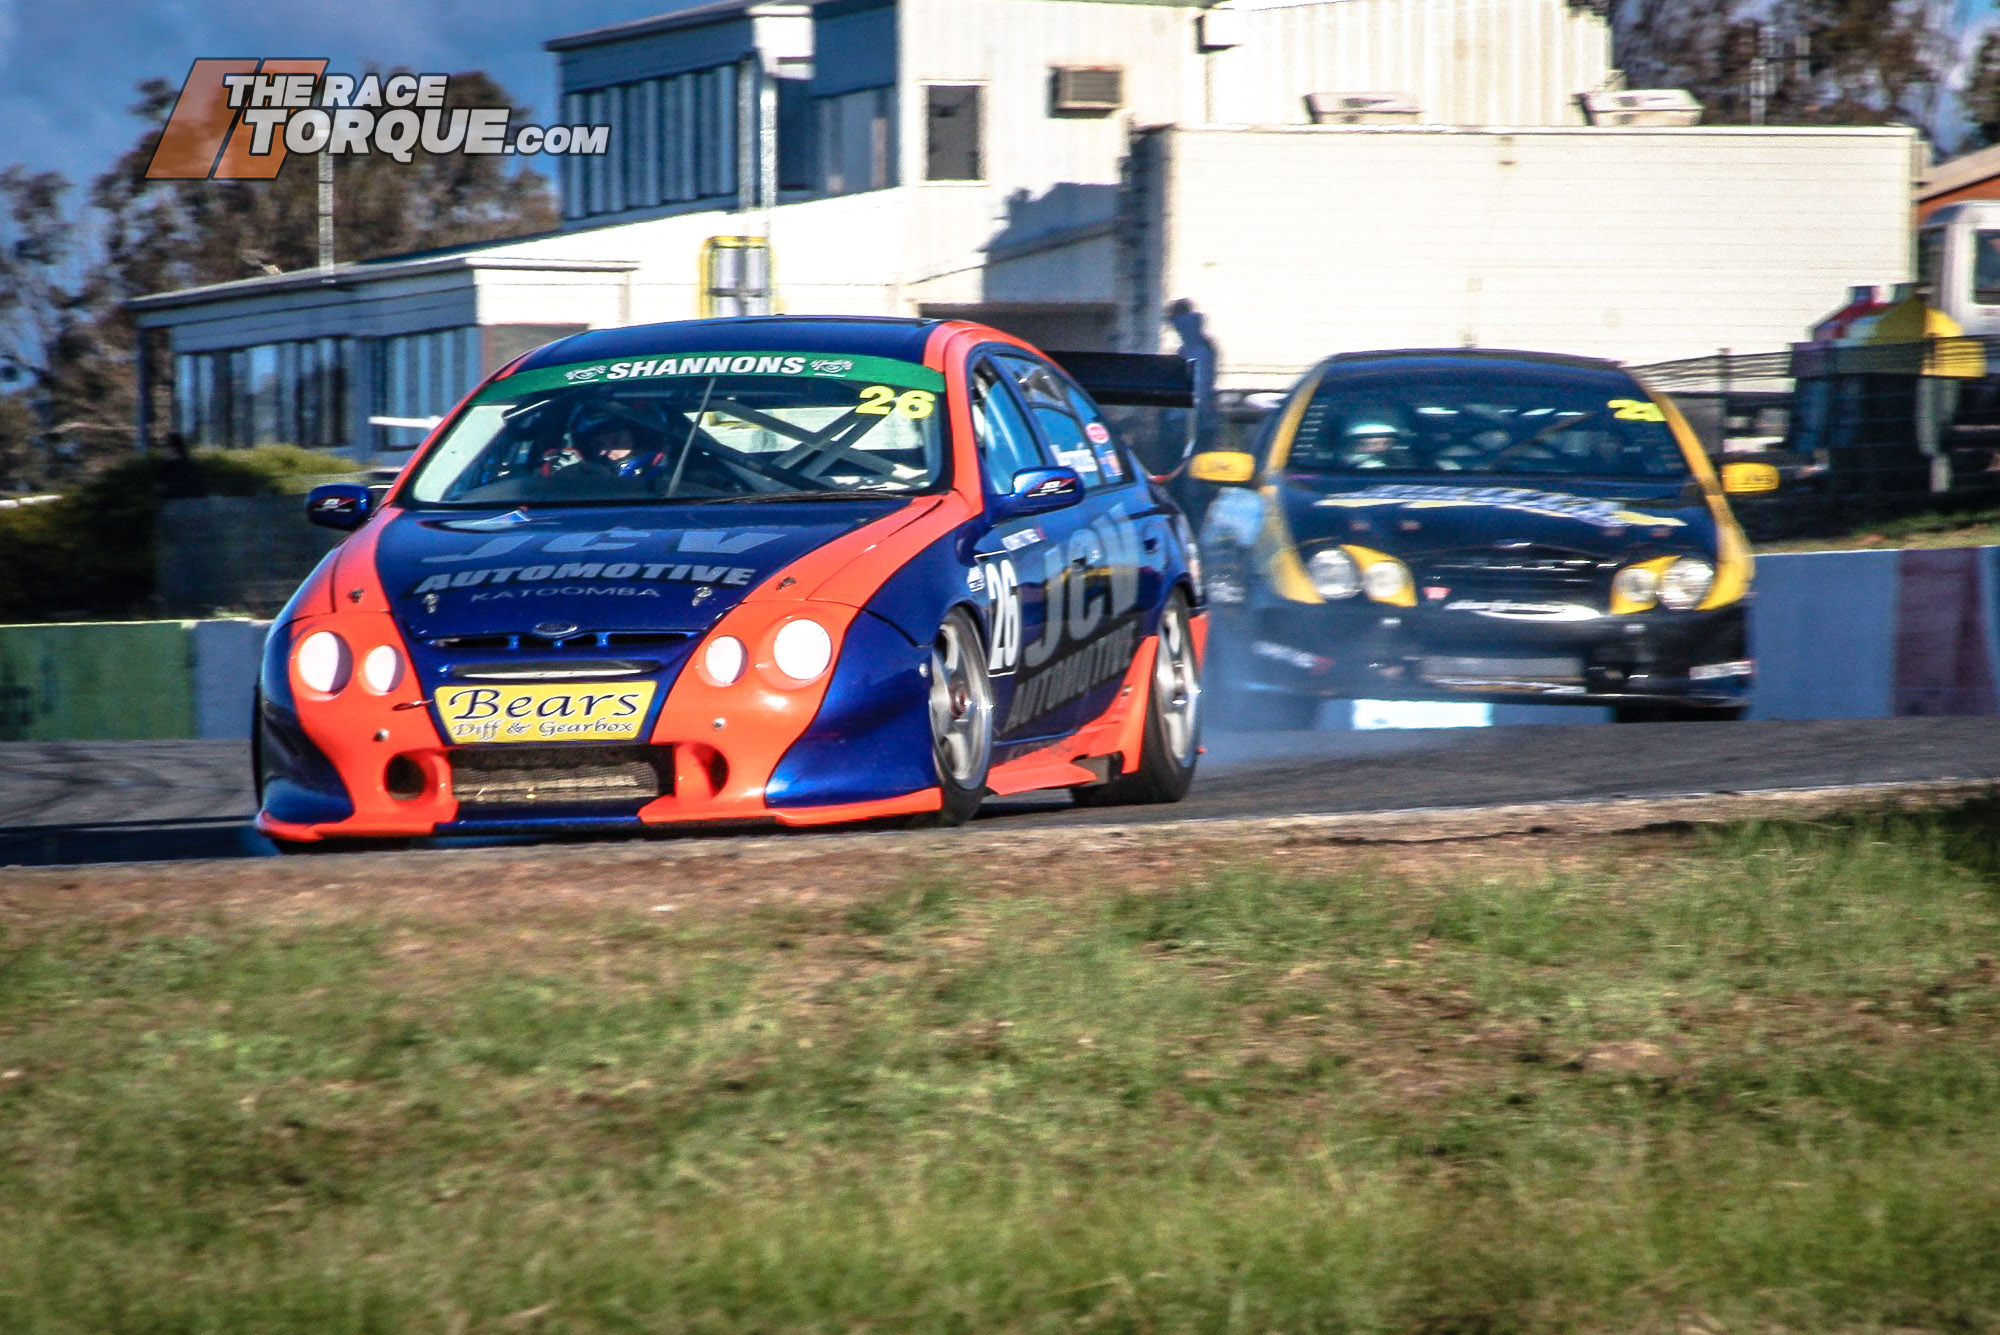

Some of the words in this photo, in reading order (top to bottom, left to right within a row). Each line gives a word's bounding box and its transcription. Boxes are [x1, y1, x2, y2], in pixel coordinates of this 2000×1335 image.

[606, 356, 806, 380] SHANNONS
[855, 386, 936, 419] 26
[421, 526, 786, 563] JCV
[414, 563, 757, 594] AUTOMOTIVE
[470, 585, 660, 602] KATOOMBA
[1023, 503, 1140, 668] JCV
[985, 559, 1019, 670] 26
[448, 688, 640, 721] Bears
[453, 720, 503, 741] Diff
[506, 721, 531, 734] &
[538, 717, 633, 737] Gearbox
